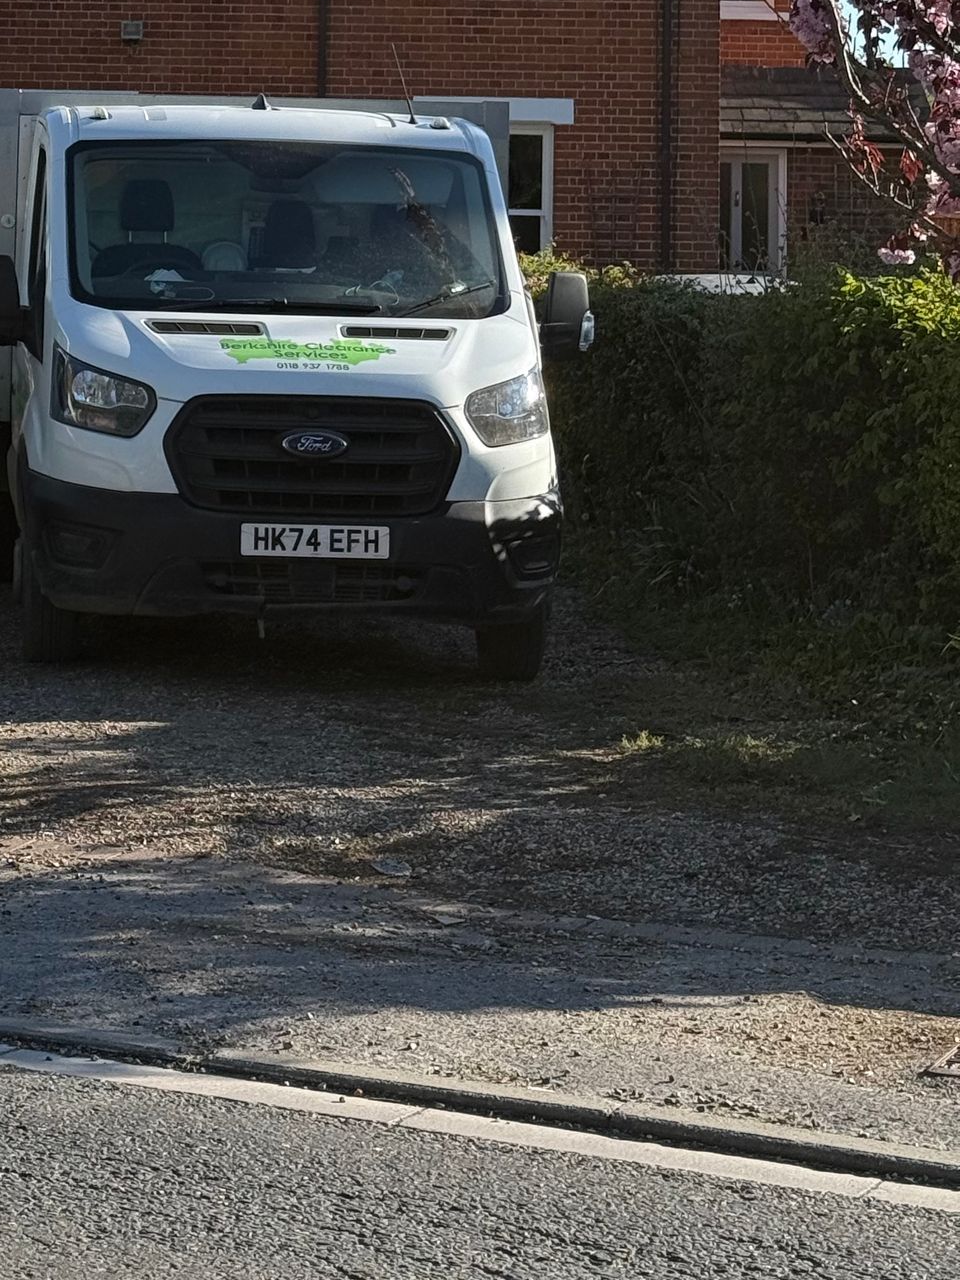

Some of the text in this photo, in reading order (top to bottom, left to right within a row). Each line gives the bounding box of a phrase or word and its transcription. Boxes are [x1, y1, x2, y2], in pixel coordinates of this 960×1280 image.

[220, 342, 397, 354] Berkshire Clearance
[273, 350, 348, 360] Services
[297, 435, 332, 452] Ford
[253, 527, 379, 553] HK74 EFH
